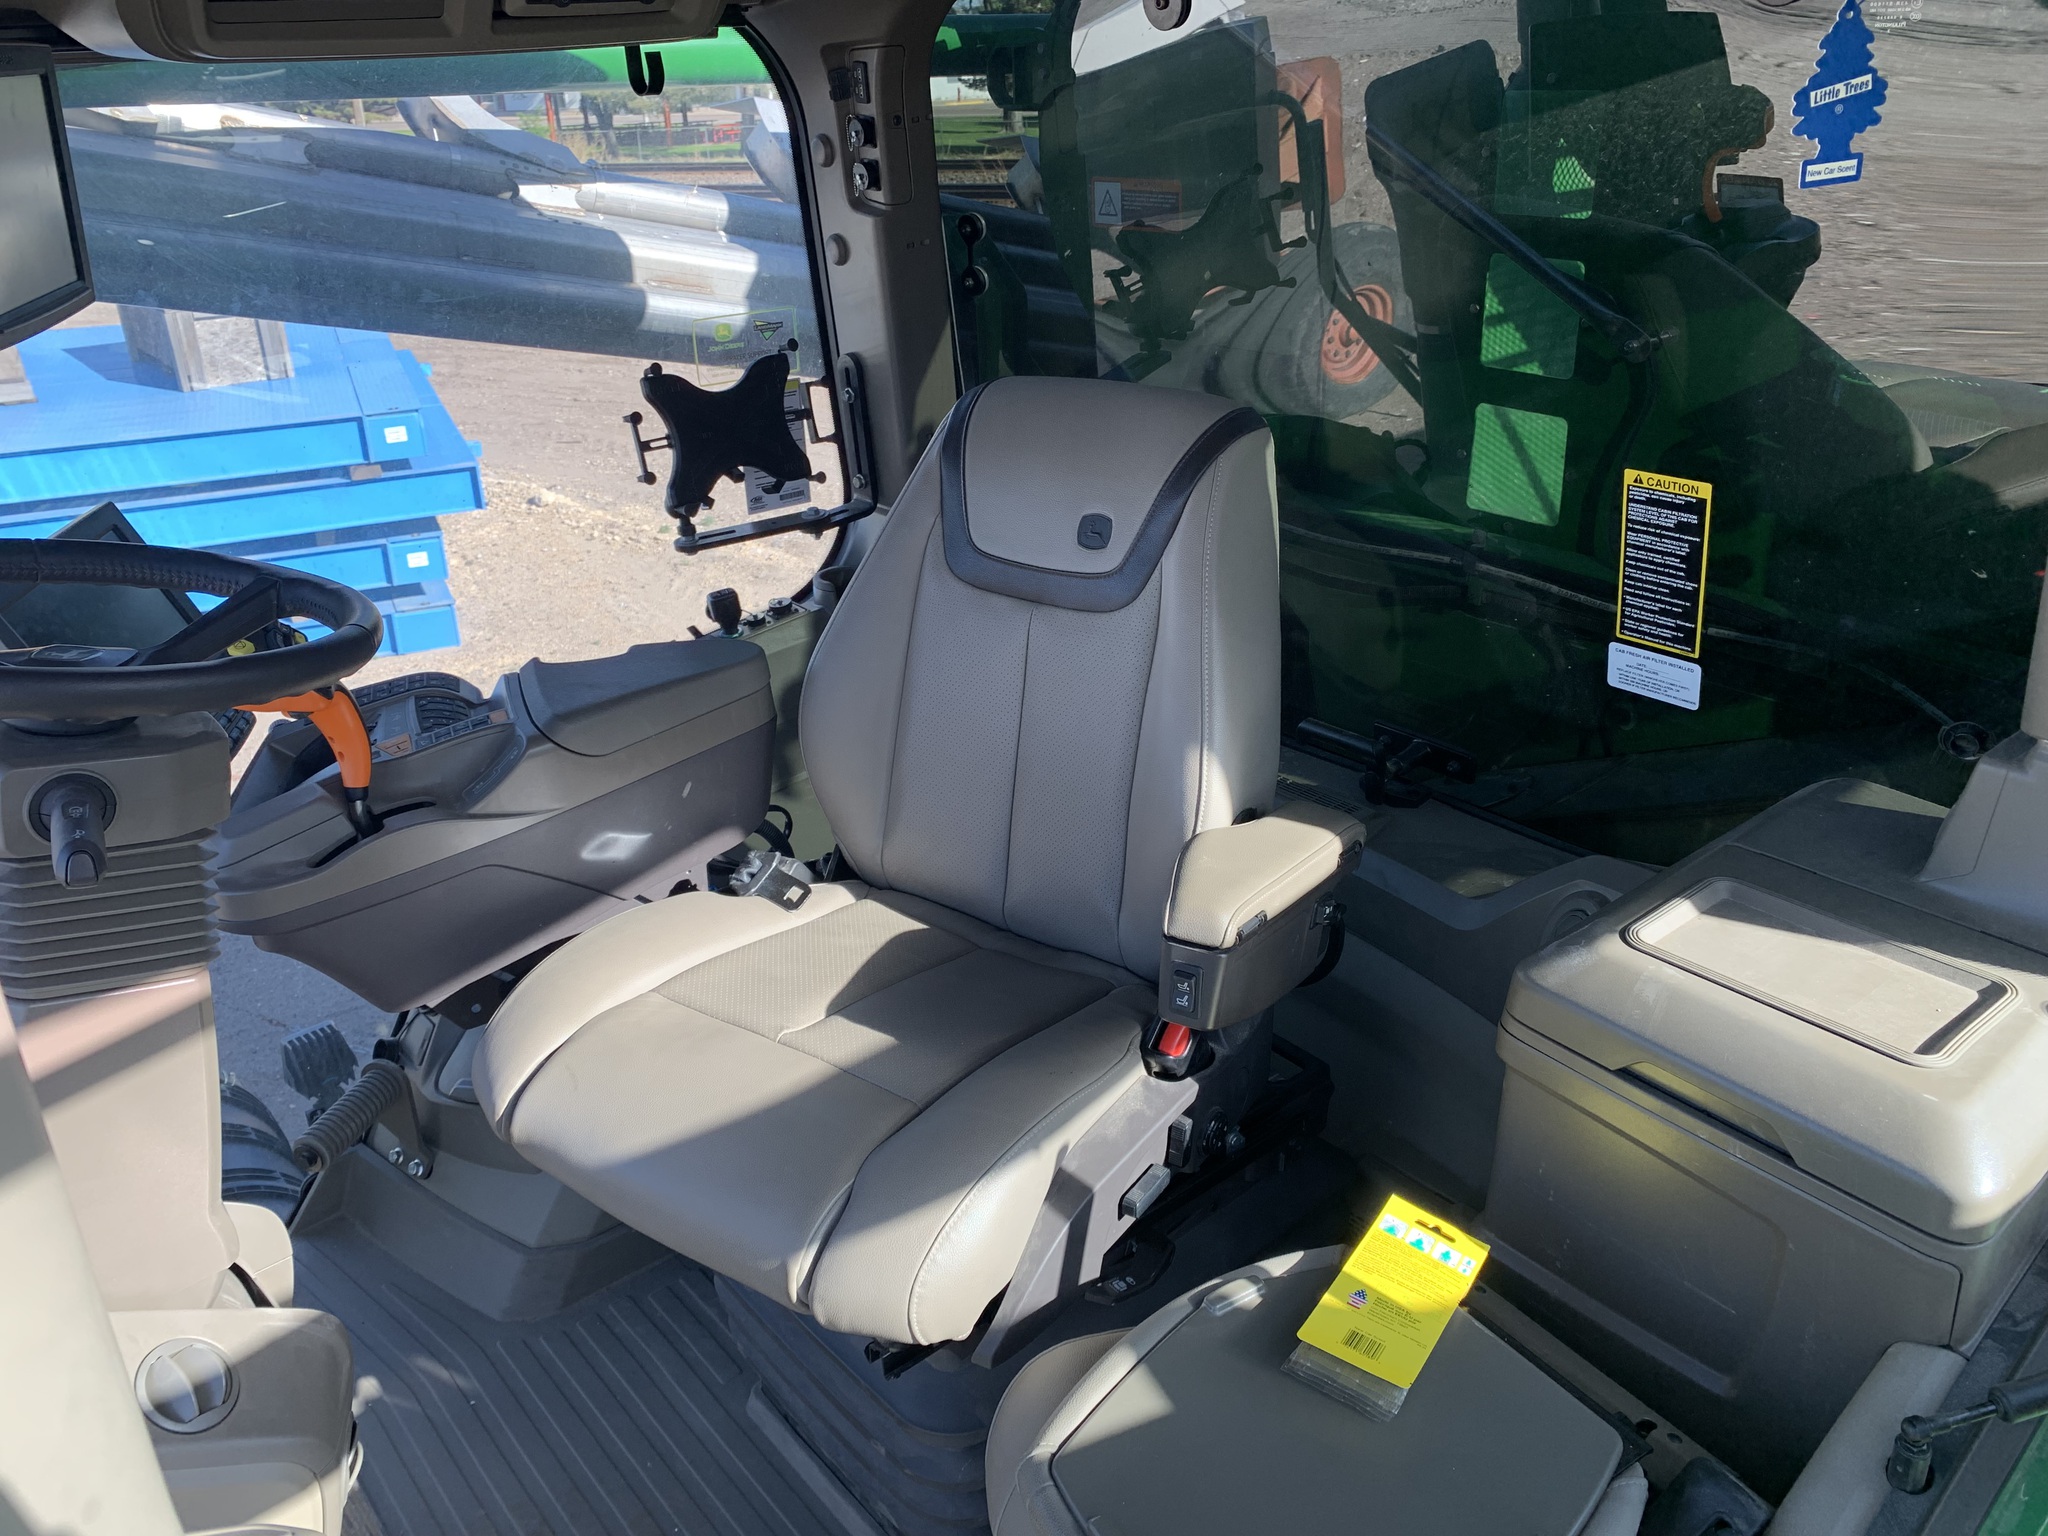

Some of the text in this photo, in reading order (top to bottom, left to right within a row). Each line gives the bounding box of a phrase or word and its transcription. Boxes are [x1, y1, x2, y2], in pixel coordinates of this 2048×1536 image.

[1814, 79, 1870, 105] Little Trees
[1807, 164, 1856, 178] New Car Scent
[1646, 477, 1699, 495] CAUTION
[1652, 658, 1667, 666] FILTER
[1668, 662, 1694, 673] INSTALLED
